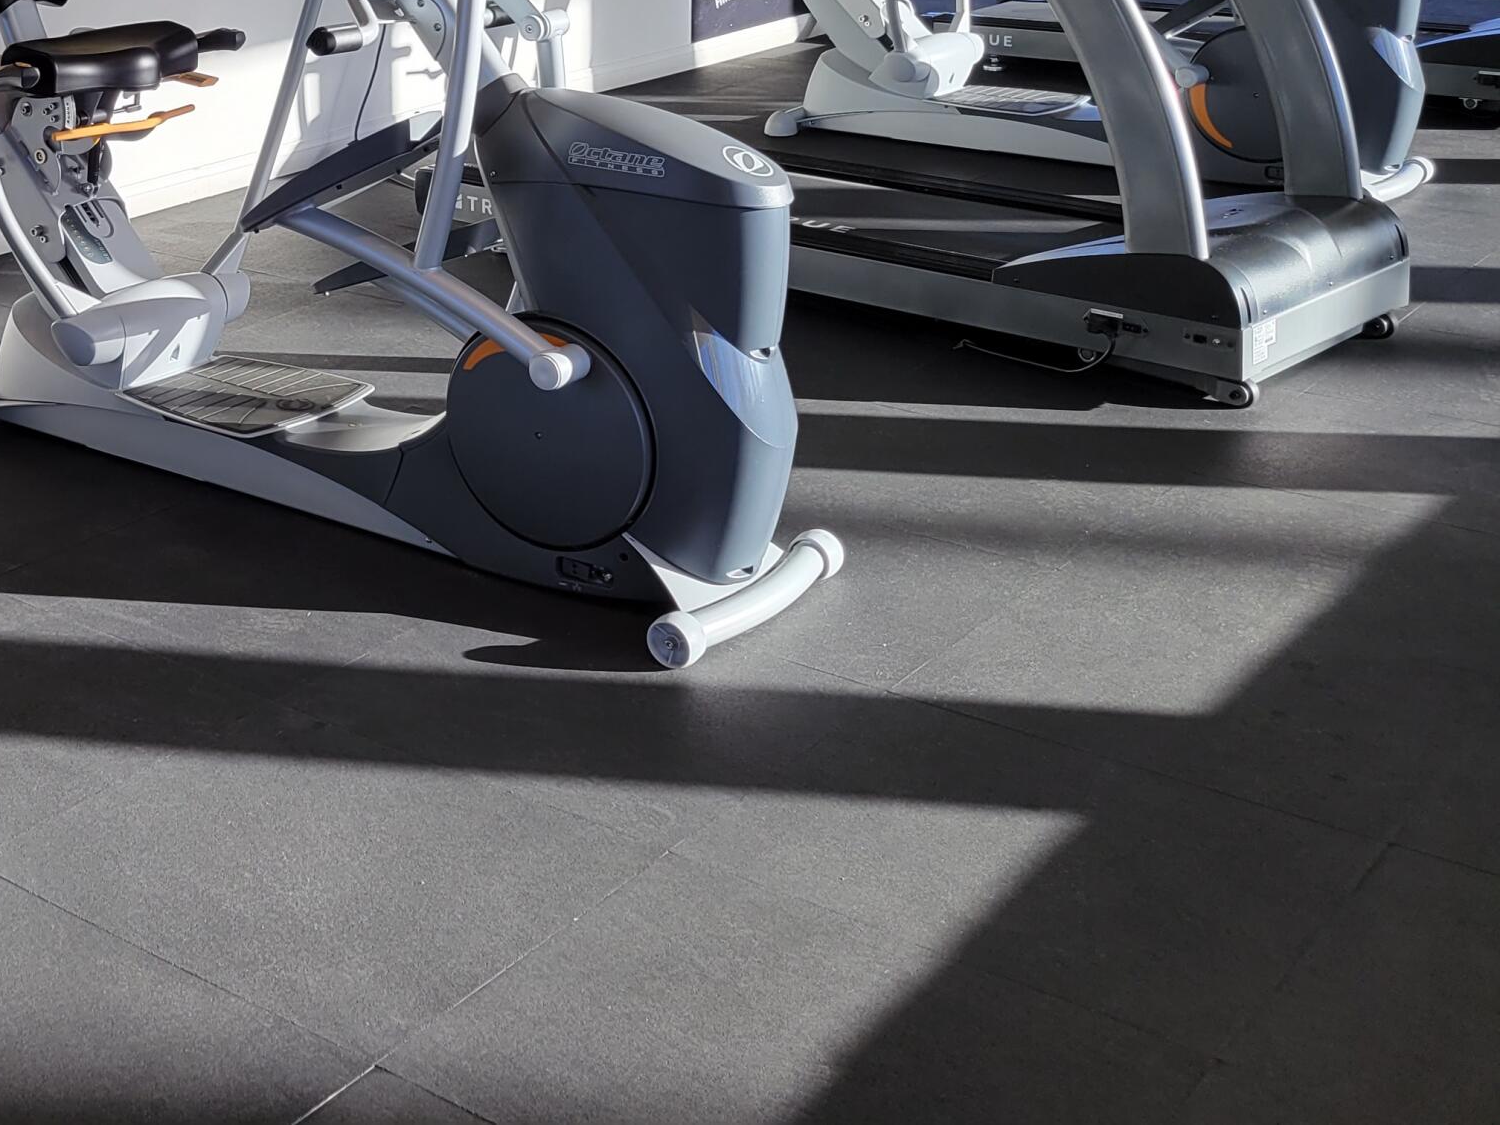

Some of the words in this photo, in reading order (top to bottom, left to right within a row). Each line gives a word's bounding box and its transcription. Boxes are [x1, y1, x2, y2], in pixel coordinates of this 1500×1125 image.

[568, 141, 665, 169] Octane
[568, 156, 664, 177] FITNESS
[466, 195, 493, 215] TR
